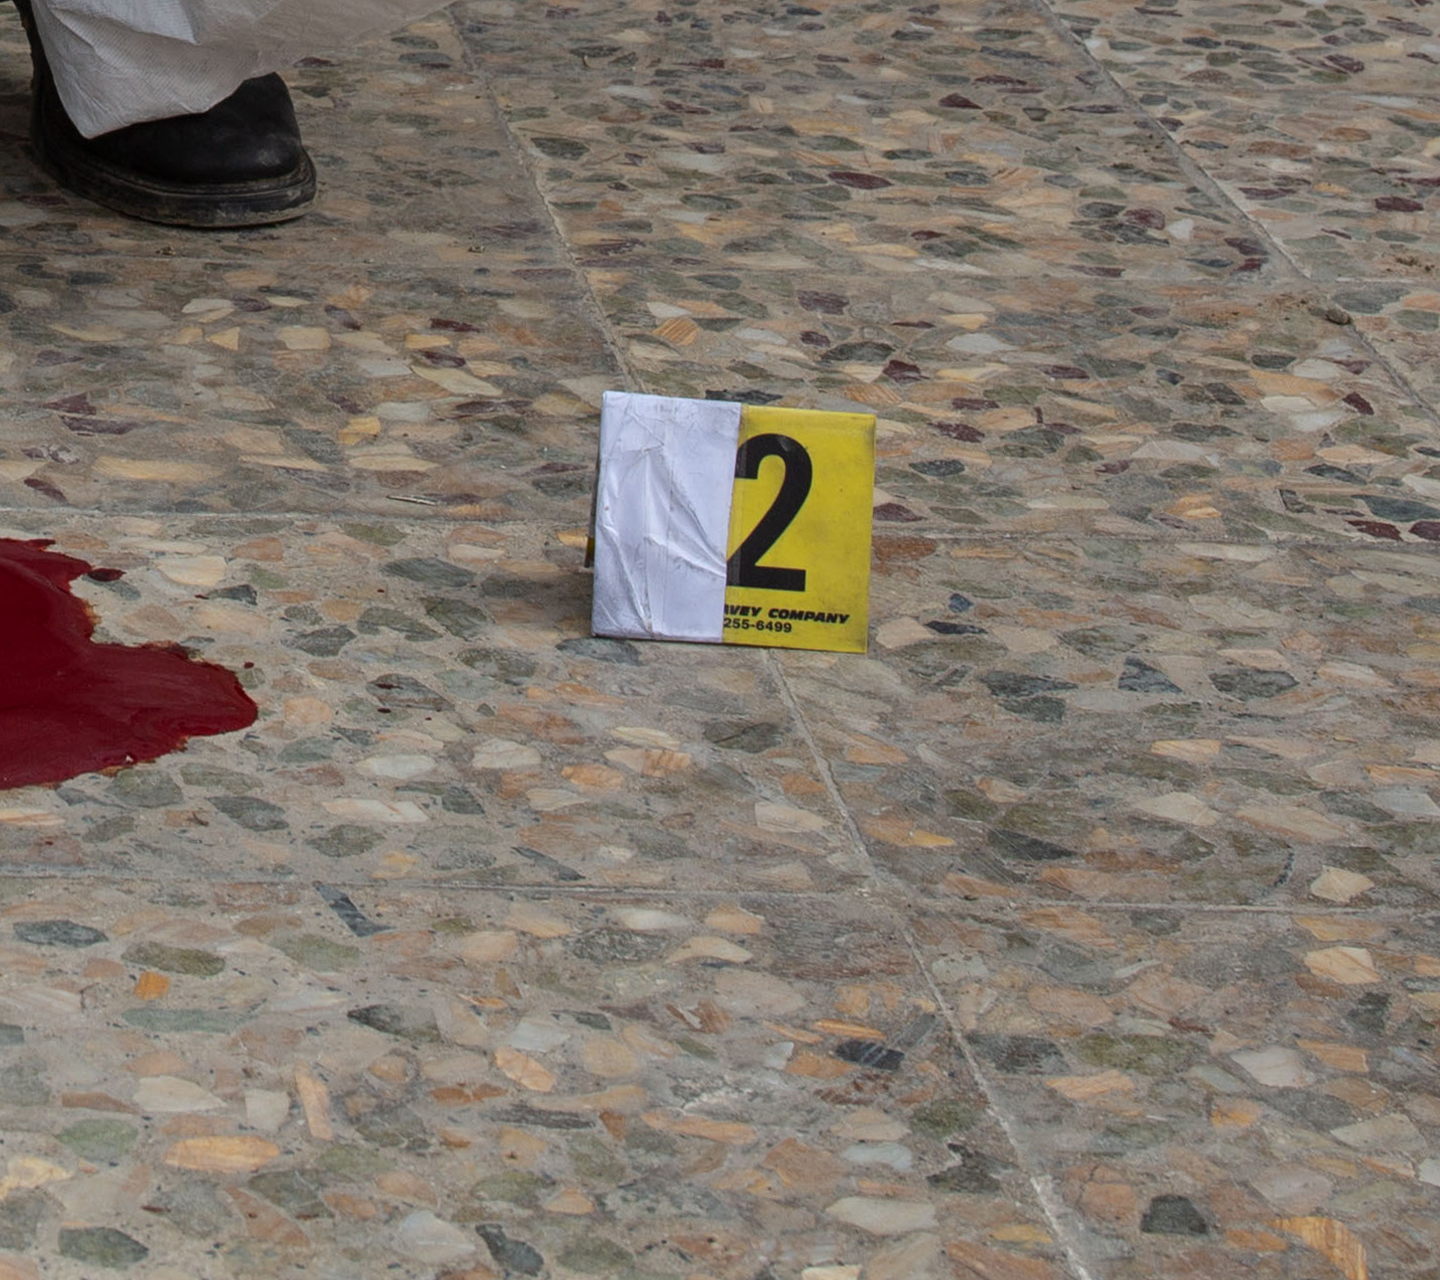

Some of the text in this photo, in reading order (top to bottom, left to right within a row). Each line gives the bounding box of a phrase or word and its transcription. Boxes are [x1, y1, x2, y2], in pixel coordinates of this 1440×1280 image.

[726, 433, 813, 592] 2
[768, 608, 850, 624] COMPANY
[724, 618, 792, 633] 255-6499
